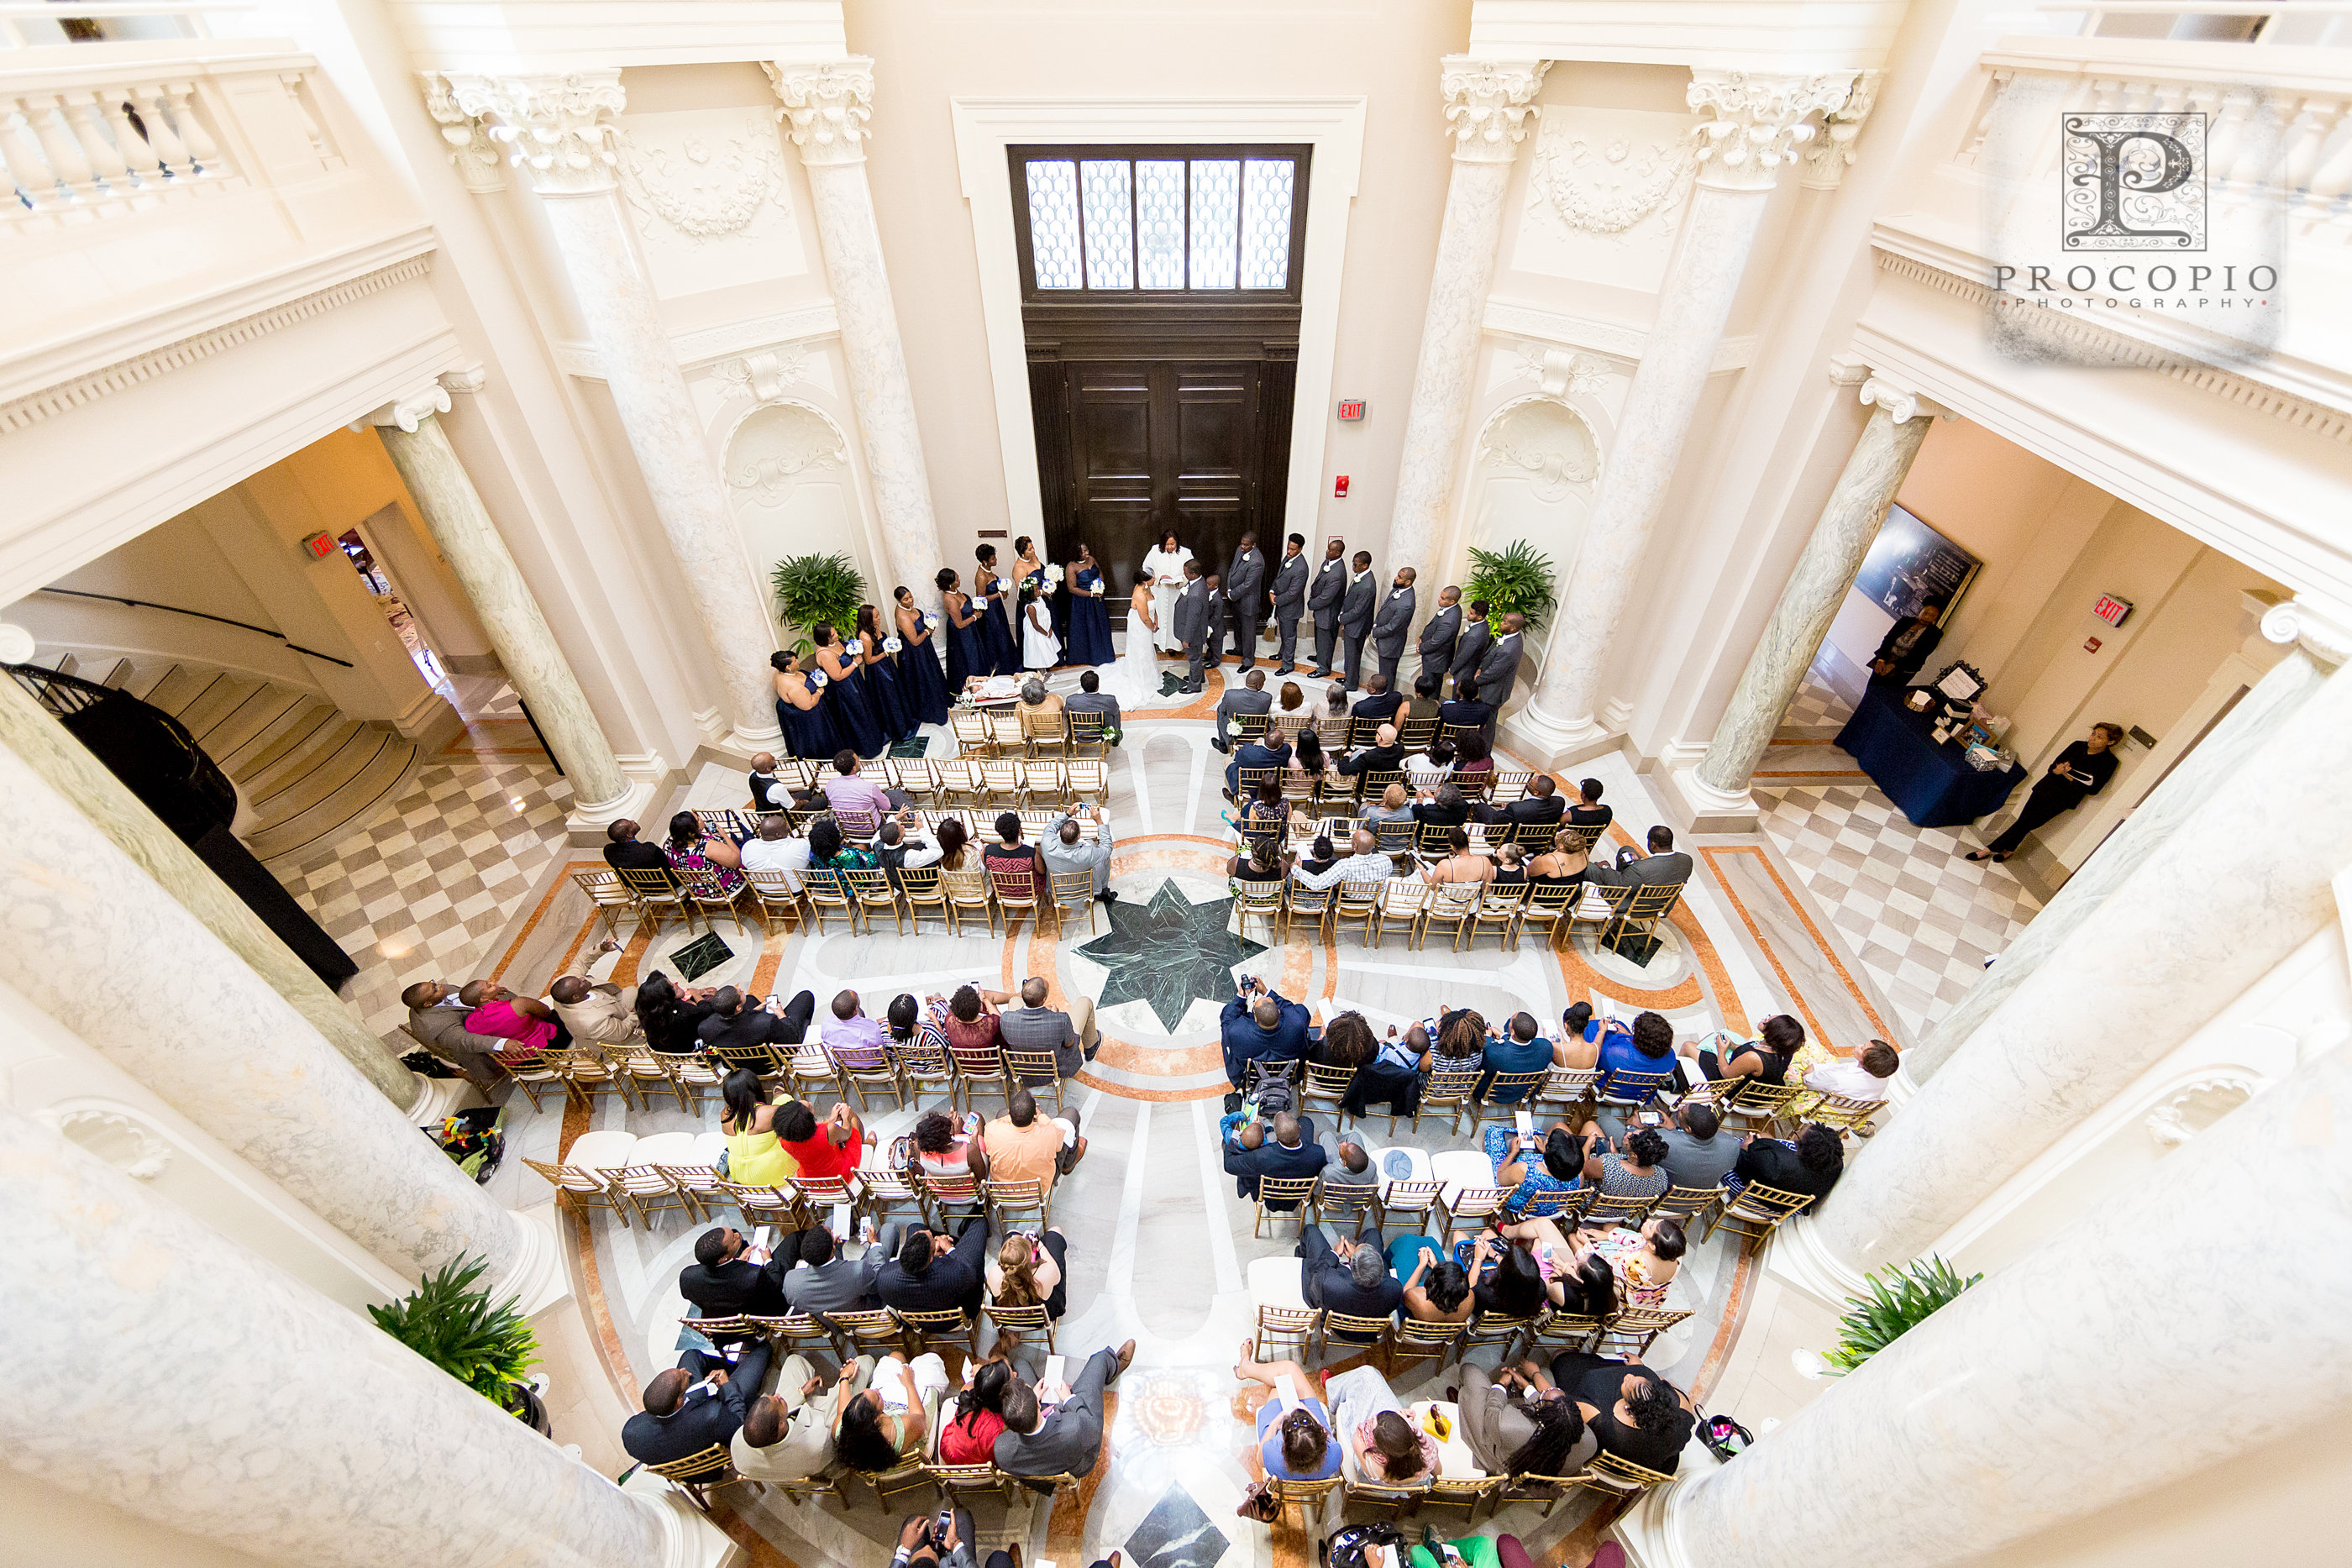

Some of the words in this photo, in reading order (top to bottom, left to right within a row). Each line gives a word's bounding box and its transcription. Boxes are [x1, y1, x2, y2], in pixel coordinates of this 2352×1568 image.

[1341, 403, 1362, 418] EXIT
[311, 533, 333, 557] EXIT
[2094, 596, 2124, 622] EXIT
